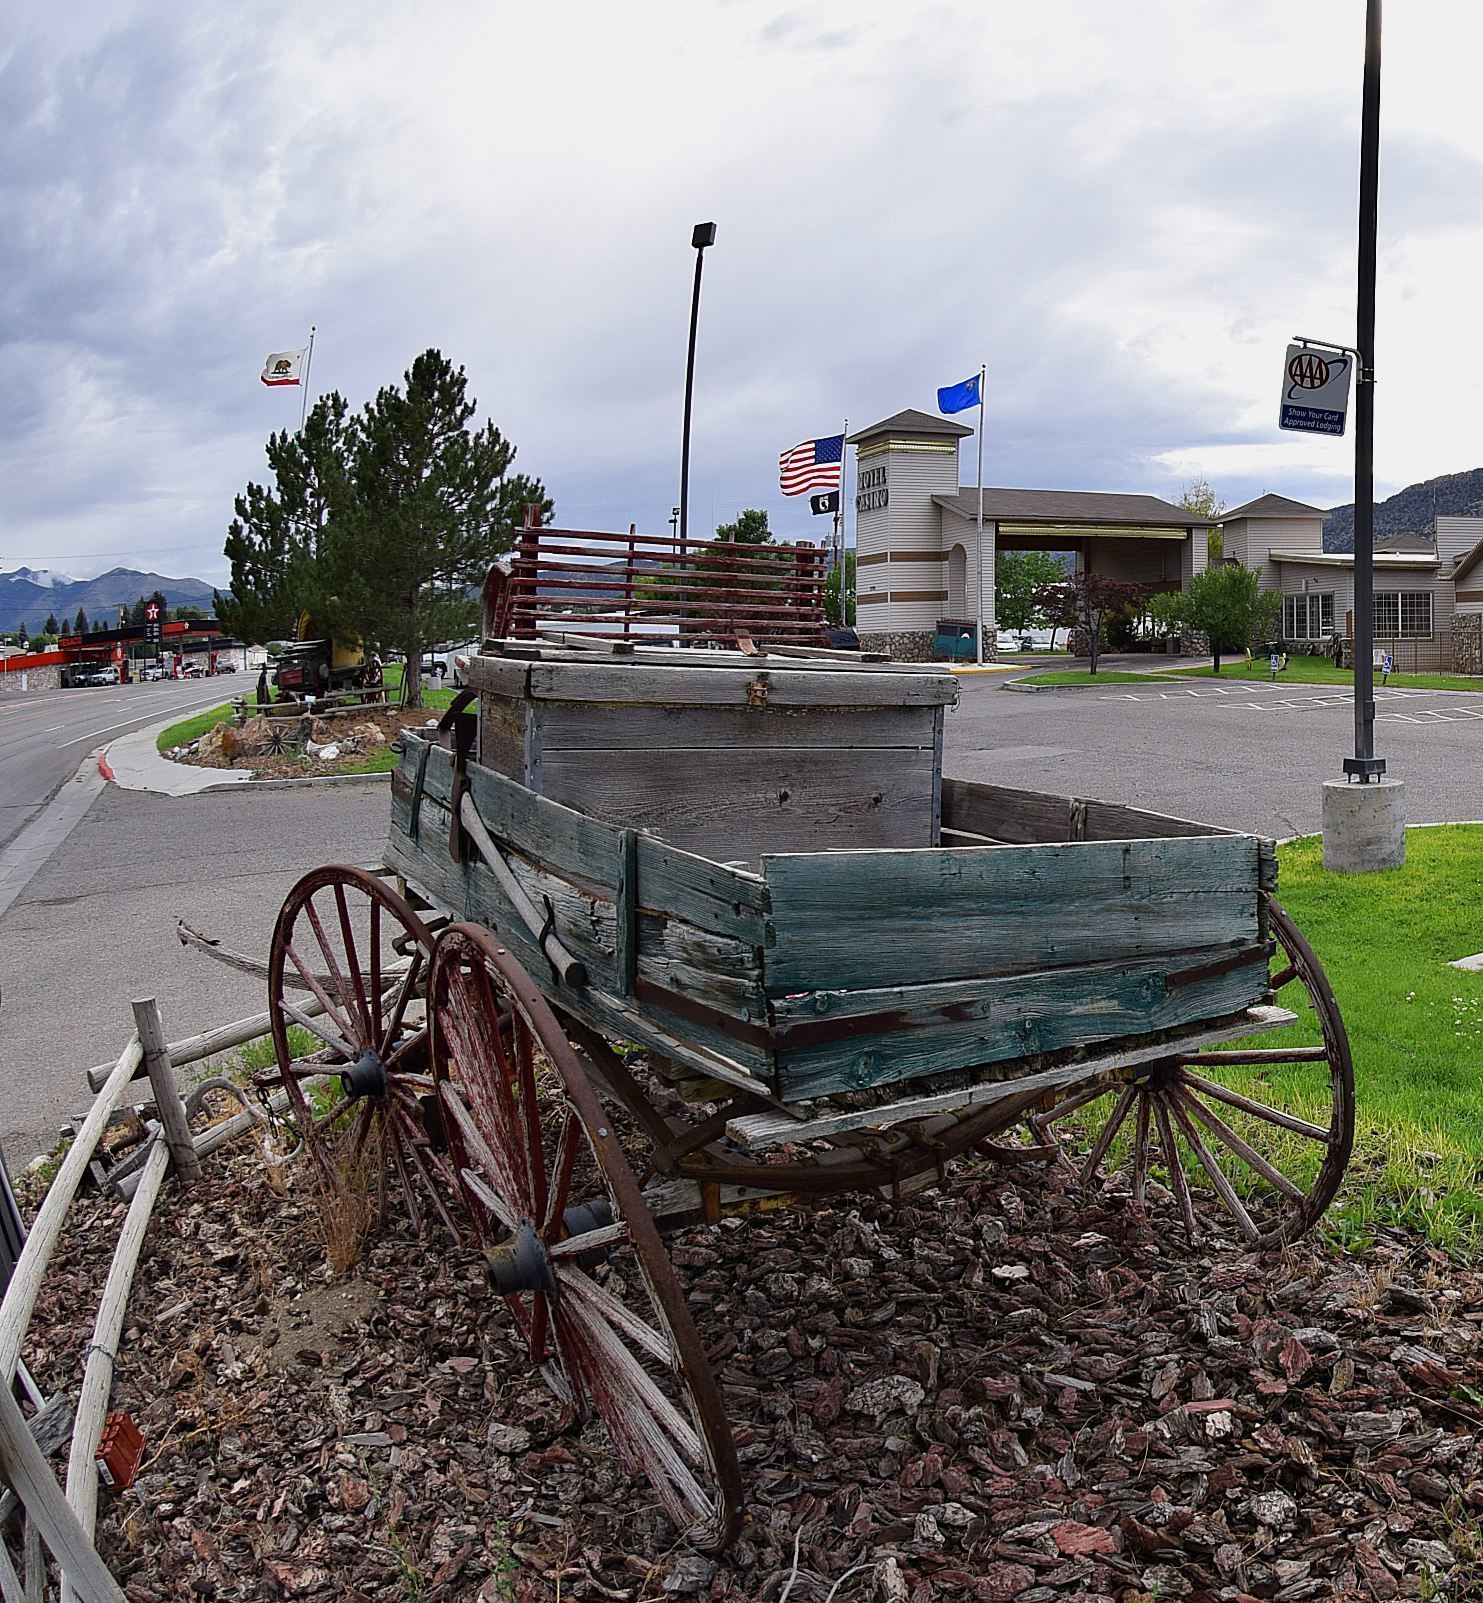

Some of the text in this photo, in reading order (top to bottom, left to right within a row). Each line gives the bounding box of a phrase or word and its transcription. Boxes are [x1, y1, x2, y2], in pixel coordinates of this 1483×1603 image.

[1289, 354, 1329, 389] AAA
[1288, 408, 1338, 421] Show Your Card
[1284, 417, 1341, 432] Approved Lodging
[856, 489, 888, 512] CASINO
